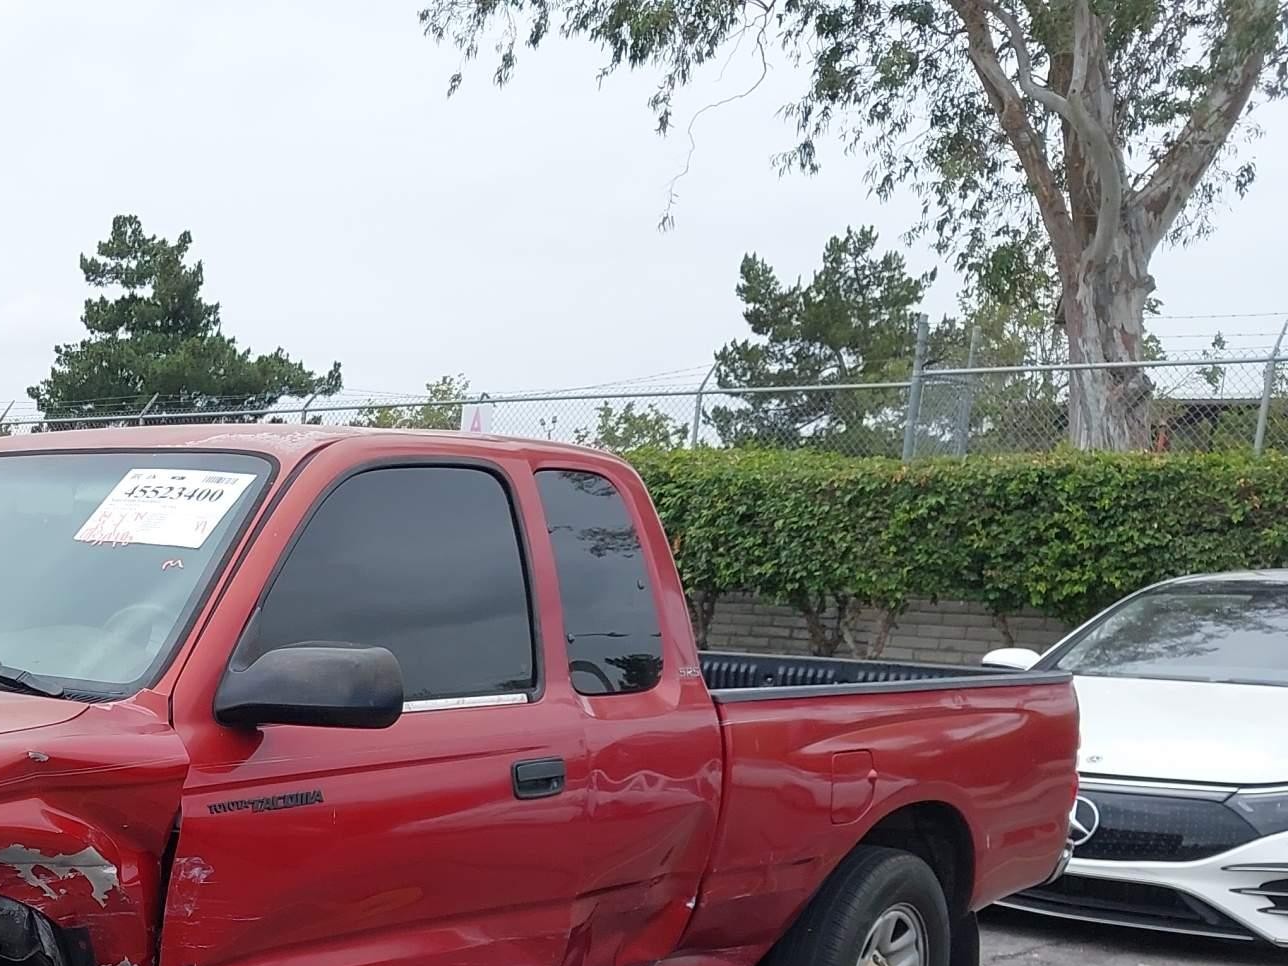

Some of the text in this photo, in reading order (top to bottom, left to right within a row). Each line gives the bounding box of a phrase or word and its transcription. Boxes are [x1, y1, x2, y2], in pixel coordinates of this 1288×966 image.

[124, 484, 225, 503] 45523400
[207, 789, 325, 815] TOYOTA TACOMA
